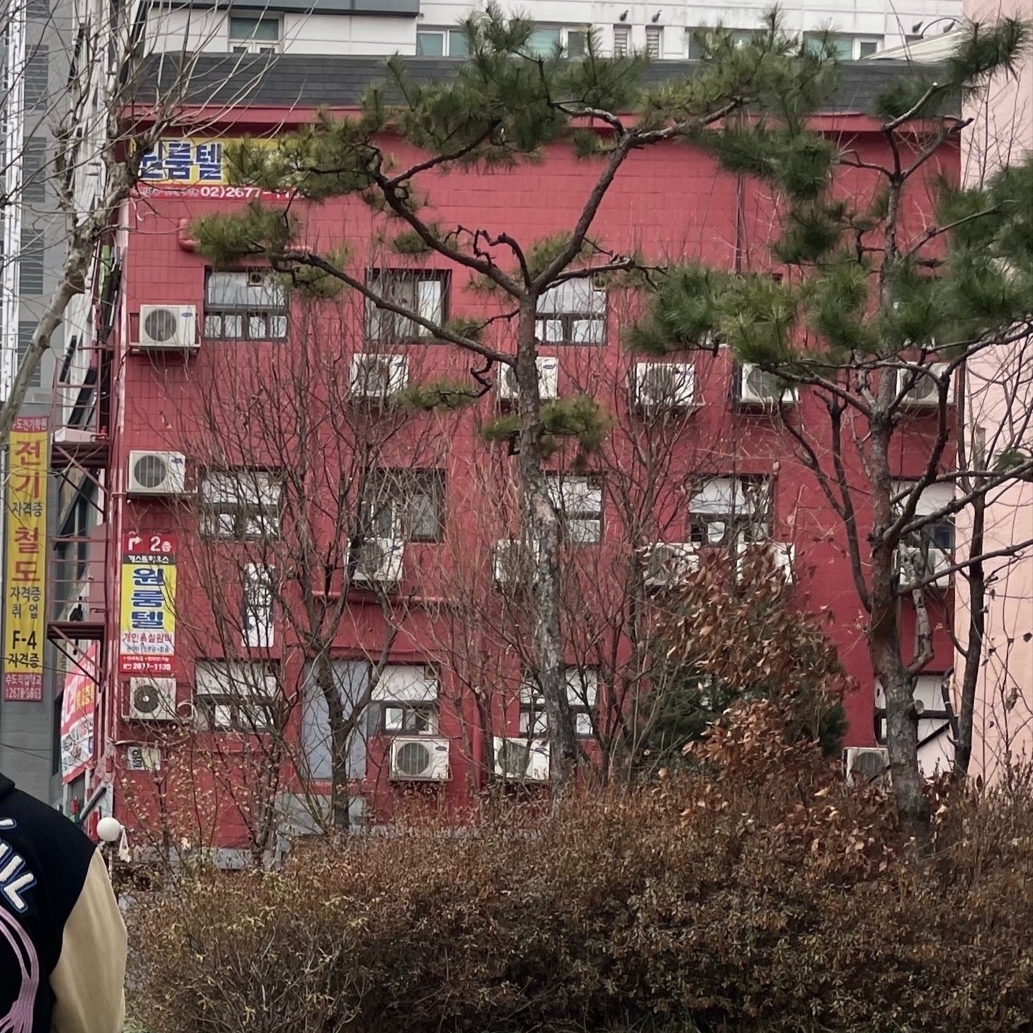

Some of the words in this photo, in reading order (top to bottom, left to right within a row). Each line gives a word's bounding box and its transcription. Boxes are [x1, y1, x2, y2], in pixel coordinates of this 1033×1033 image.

[15, 440, 41, 499] 전기
[12, 502, 43, 517] 자격증
[11, 527, 40, 582] 철도
[10, 586, 41, 602] 자격증
[131, 568, 165, 629] 원룸텔
[12, 630, 37, 650] F-4
[8, 653, 40, 669] 자격증
